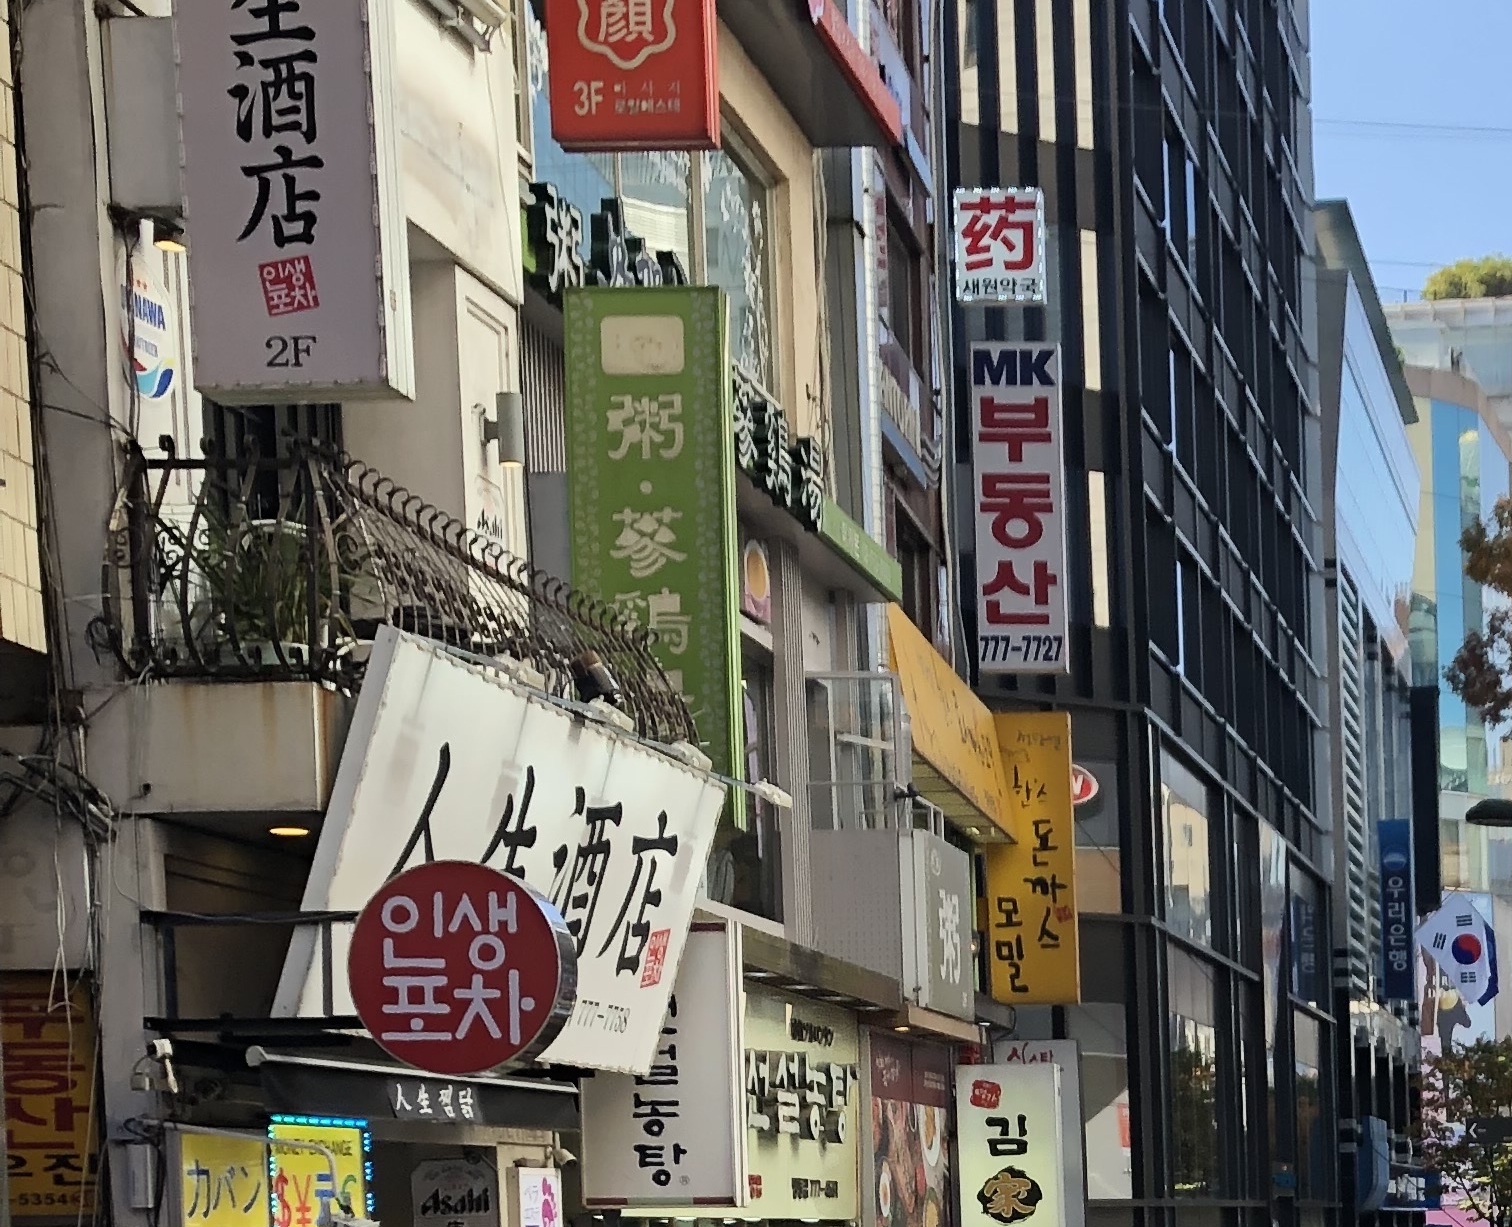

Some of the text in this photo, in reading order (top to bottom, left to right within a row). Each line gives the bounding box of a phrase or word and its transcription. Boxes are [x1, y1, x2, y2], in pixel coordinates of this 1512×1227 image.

[573, 79, 605, 117] 3F
[958, 194, 1037, 272] 药
[962, 276, 1039, 296] 새원약국
[265, 335, 317, 368] 2F
[972, 348, 1057, 386] MK
[978, 395, 1059, 625] 부동산
[978, 634, 1064, 664] 777-7727
[1022, 818, 1069, 950] 돈까스
[381, 890, 518, 971] 인생
[994, 896, 1030, 993] 모밀
[1386, 876, 1408, 972] 우리은행
[381, 968, 536, 1046] 포차
[577, 999, 631, 1034] 777-7758
[186, 1158, 261, 1219] カバン
[420, 1186, 490, 1217] Asahi
